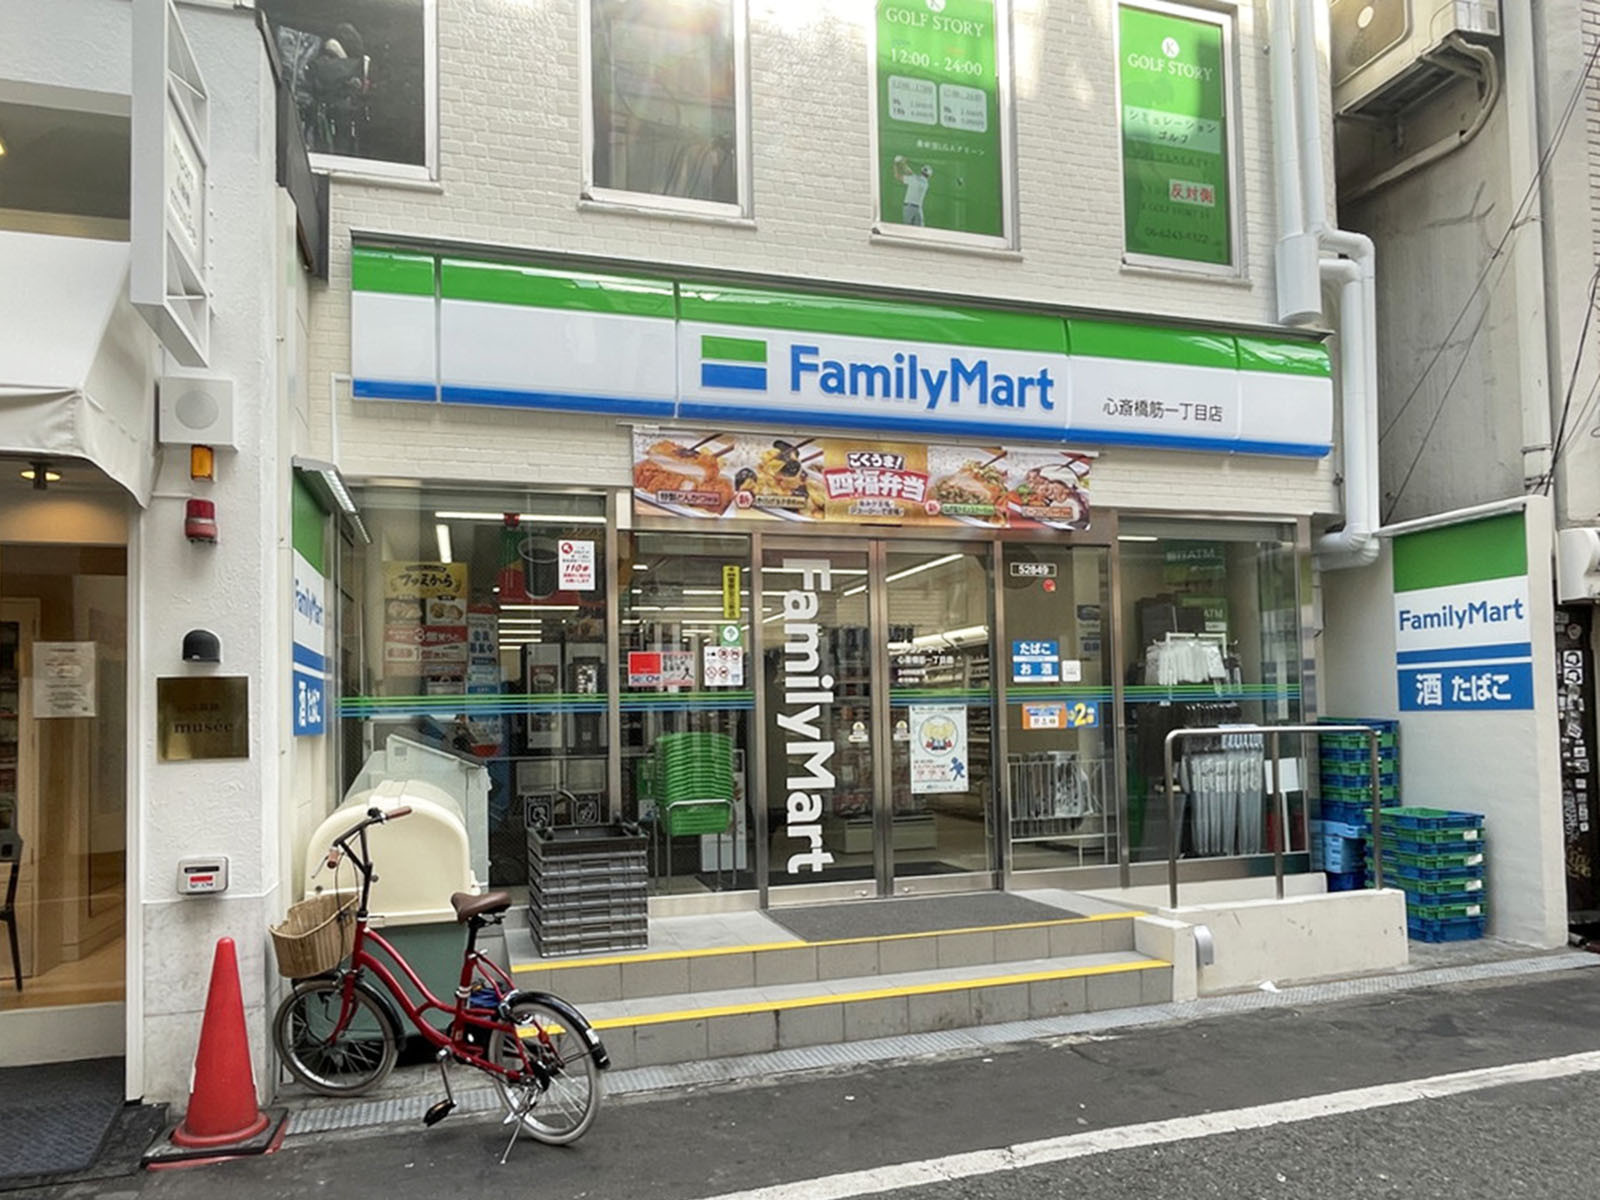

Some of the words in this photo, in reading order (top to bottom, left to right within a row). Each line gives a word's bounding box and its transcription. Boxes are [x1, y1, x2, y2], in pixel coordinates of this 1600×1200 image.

[886, 8, 928, 27] GOLF
[933, 16, 984, 37] STORY
[890, 48, 930, 67] 12:00
[944, 57, 982, 76] 24:00
[1127, 53, 1164, 72] GOLF
[1168, 61, 1212, 81] STORY
[790, 344, 1054, 411] FamilyMart
[1103, 397, 1223, 422] 心斎橋筋一丁目店
[826, 469, 925, 502] 四福弁当
[1399, 598, 1524, 631] FamilyMart
[1019, 642, 1051, 655] たばこ
[1415, 673, 1443, 706] 酒
[1451, 672, 1512, 703] たばこ
[777, 558, 836, 874] FamilyMart
